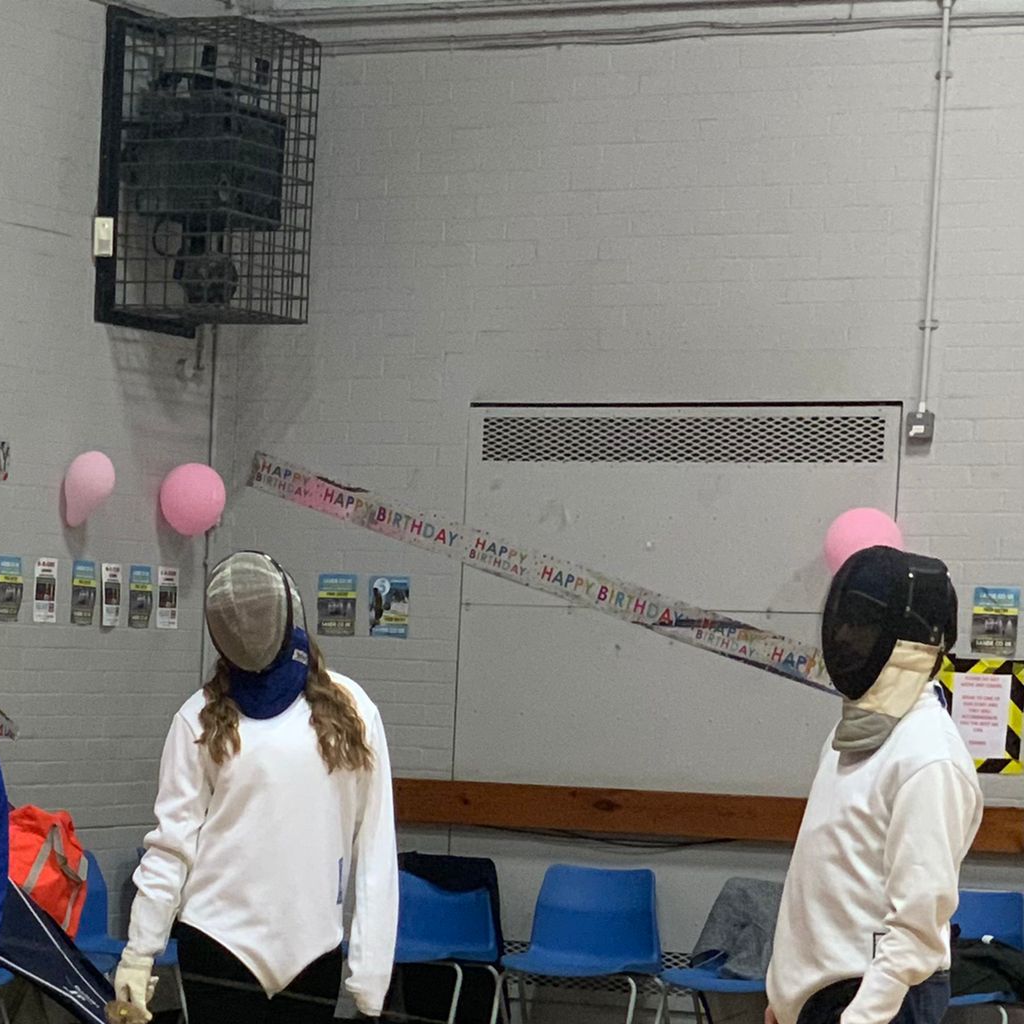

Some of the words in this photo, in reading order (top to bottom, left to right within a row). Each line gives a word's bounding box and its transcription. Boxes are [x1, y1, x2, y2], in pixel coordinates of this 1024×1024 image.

[255, 471, 309, 497] BIRTHDAY
[260, 457, 311, 486] HAPPY
[323, 487, 375, 513] HAPPY
[376, 506, 458, 547] BIRTHDAY
[468, 548, 527, 577] BIRTHDAY
[475, 536, 528, 564] HAPPY
[540, 565, 594, 595] HAPPY
[597, 585, 683, 625] BIRTHDAY
[695, 629, 754, 659] BIRTHDAY
